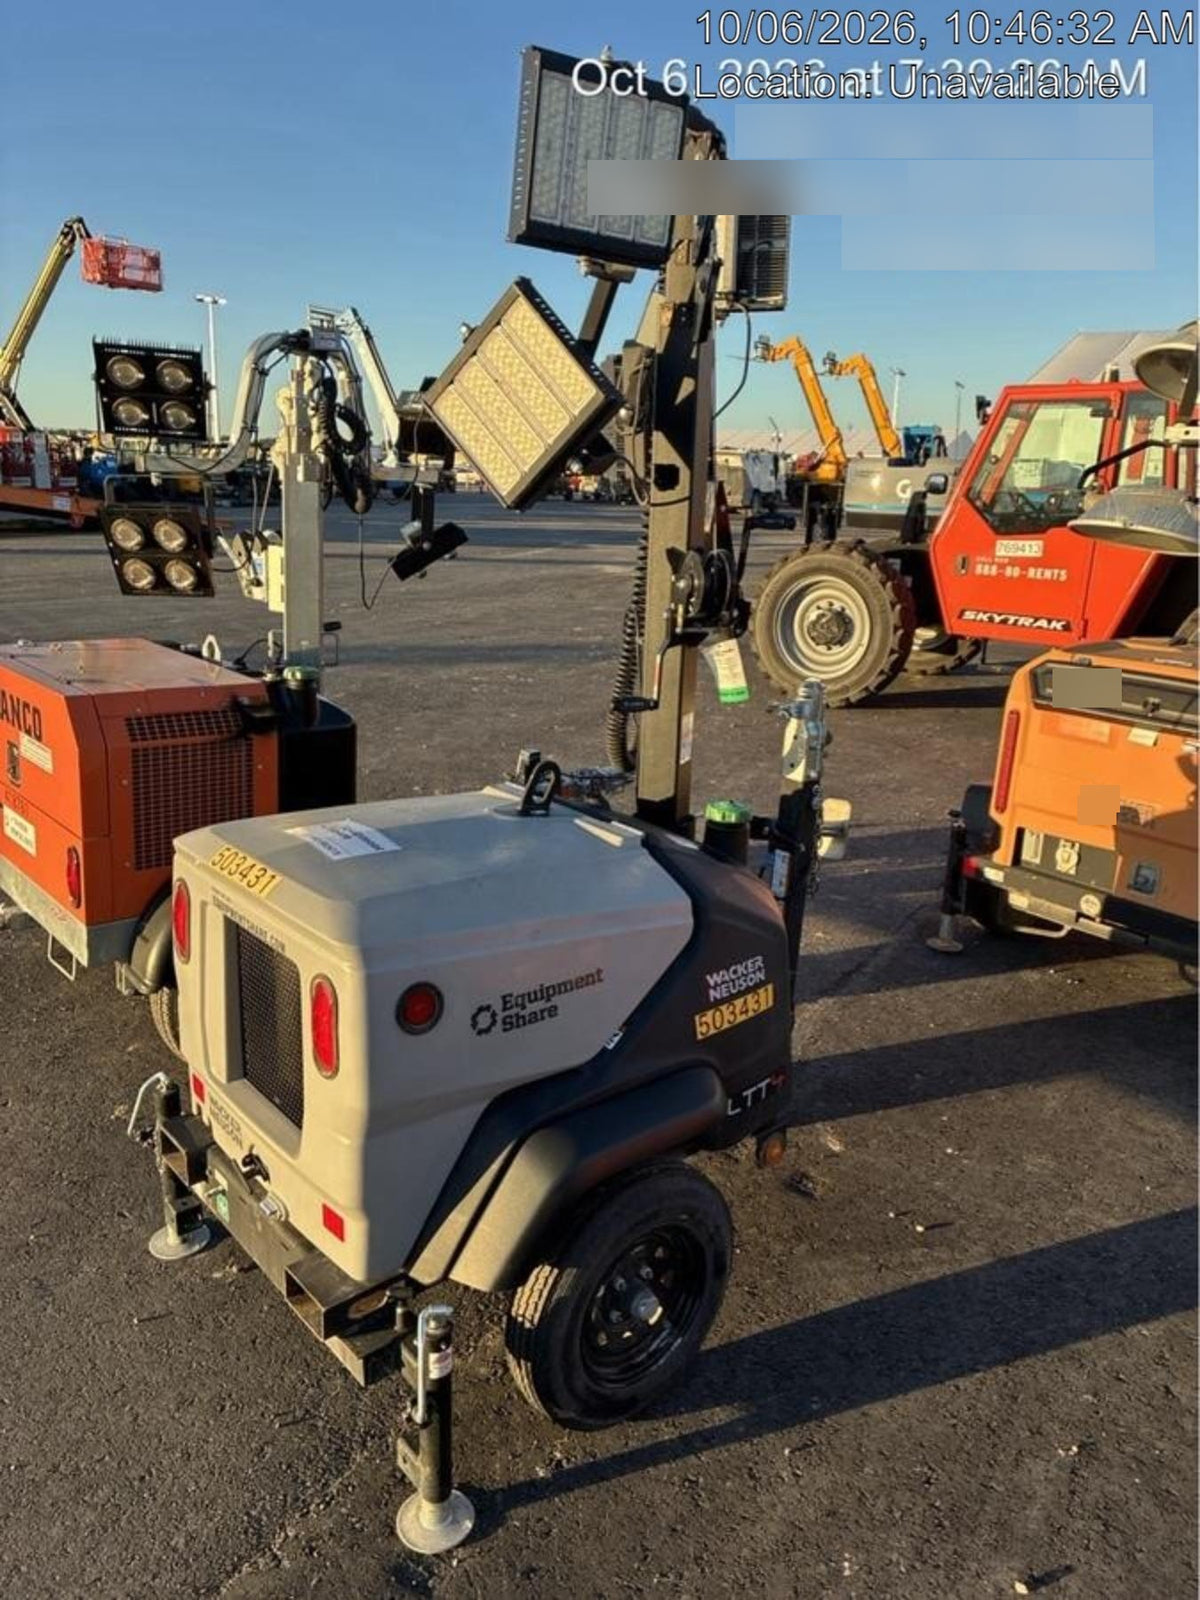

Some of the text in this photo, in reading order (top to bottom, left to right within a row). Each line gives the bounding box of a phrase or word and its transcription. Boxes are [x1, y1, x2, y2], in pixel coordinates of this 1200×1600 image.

[961, 609, 1067, 631] SKYTRAK
[210, 846, 277, 895] 503431
[705, 954, 764, 988] WACKER
[708, 967, 767, 1003] NEUSON
[501, 967, 605, 1013] Equipment
[501, 1003, 559, 1033] Share
[698, 986, 771, 1037] 503431
